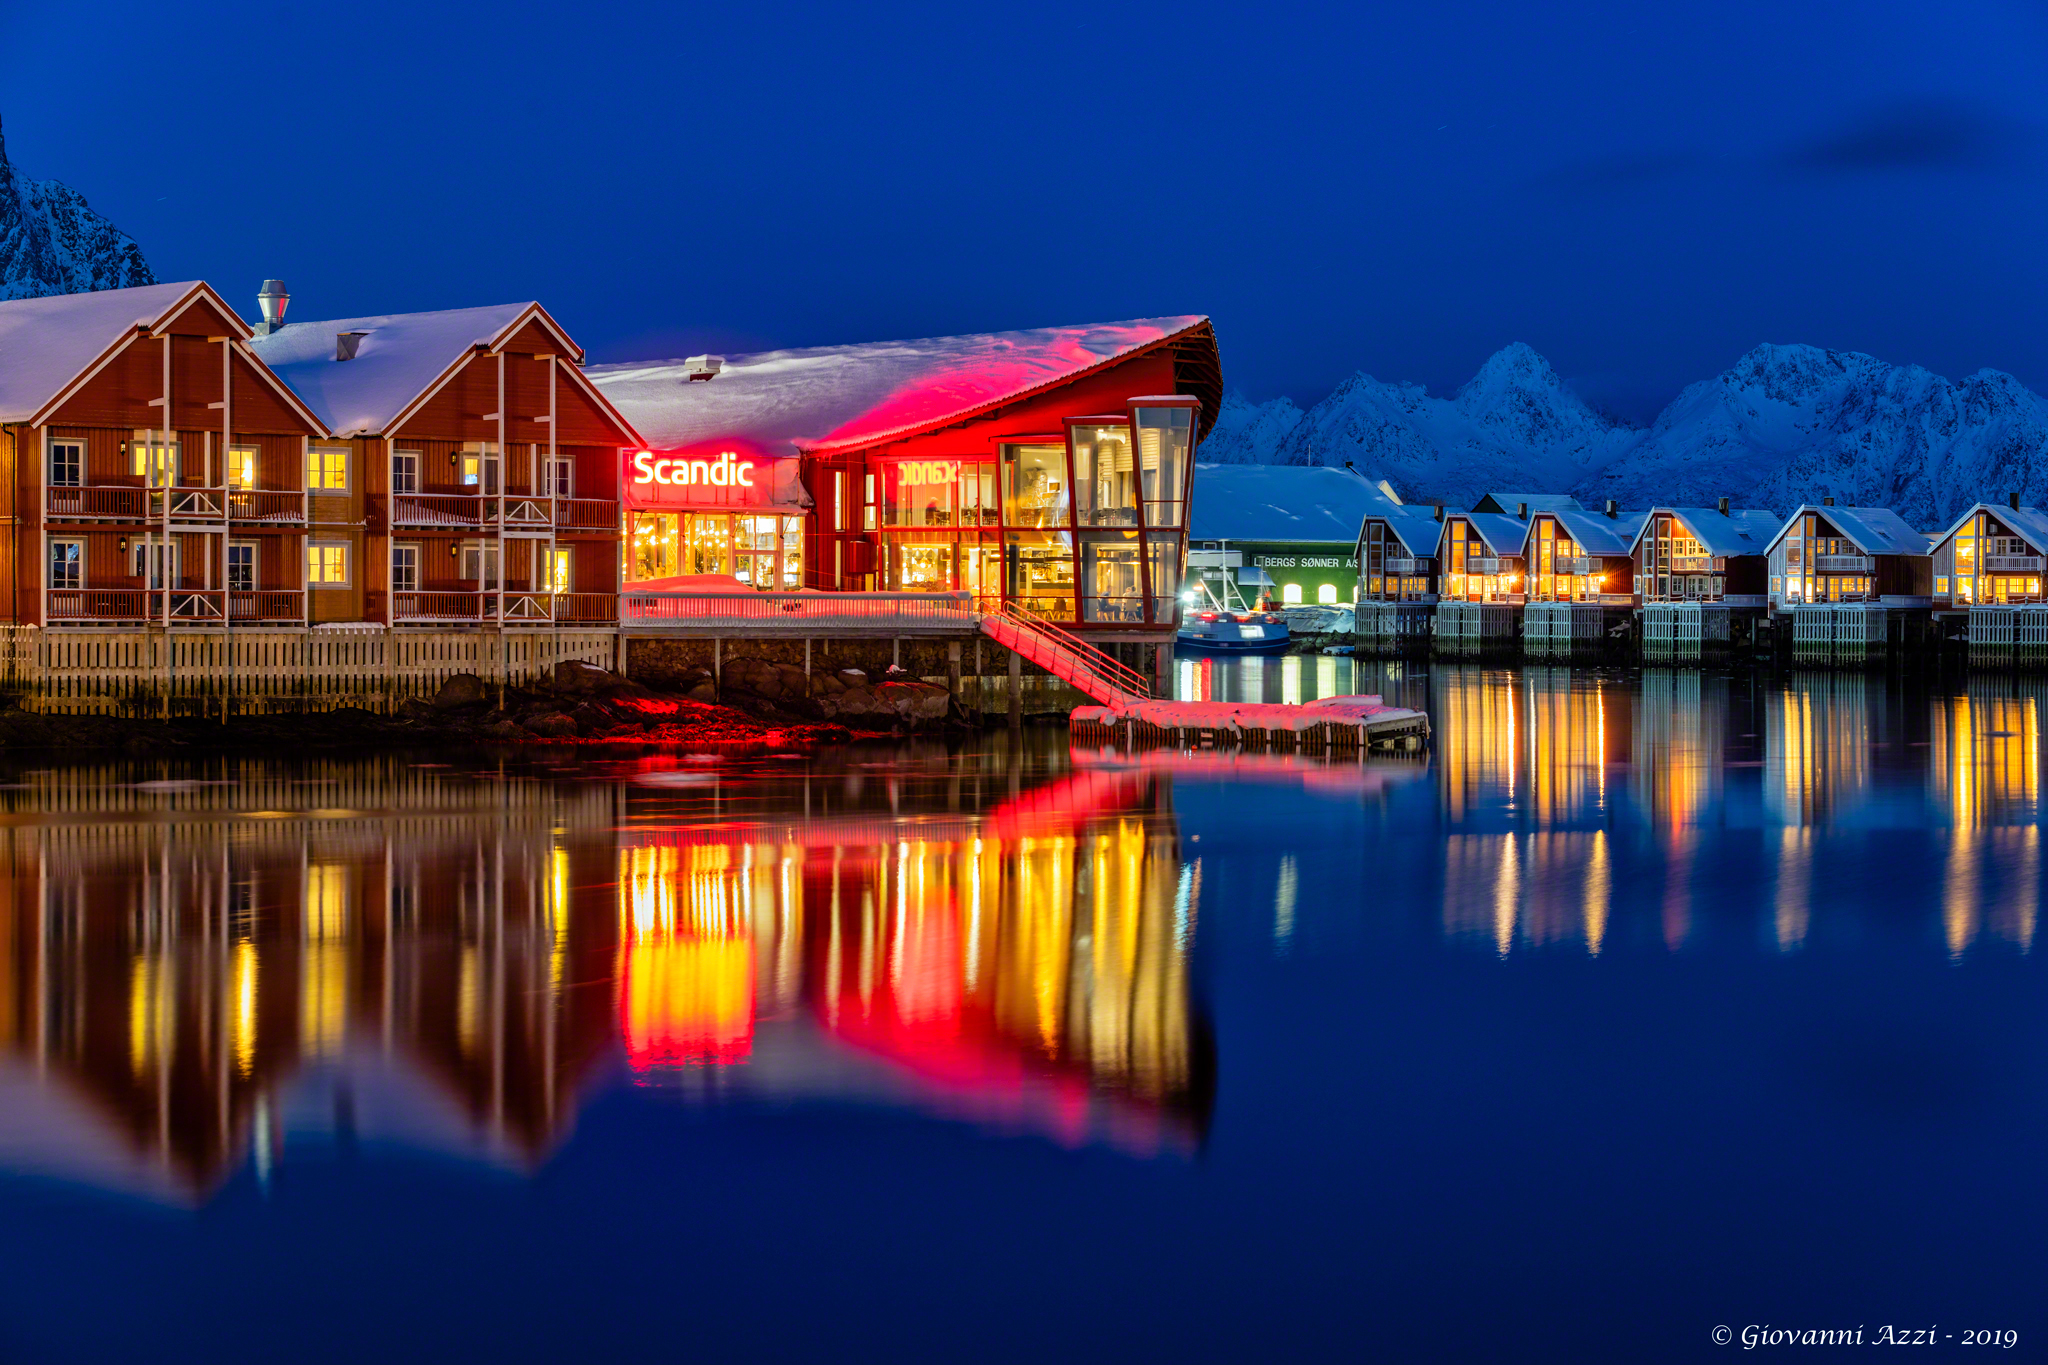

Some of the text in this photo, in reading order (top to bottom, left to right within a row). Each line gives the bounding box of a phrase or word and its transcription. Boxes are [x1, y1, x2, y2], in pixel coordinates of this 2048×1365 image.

[634, 451, 753, 486] Scandic
[1265, 557, 1296, 567] BERGS
[1301, 558, 1339, 568] SØNNER
